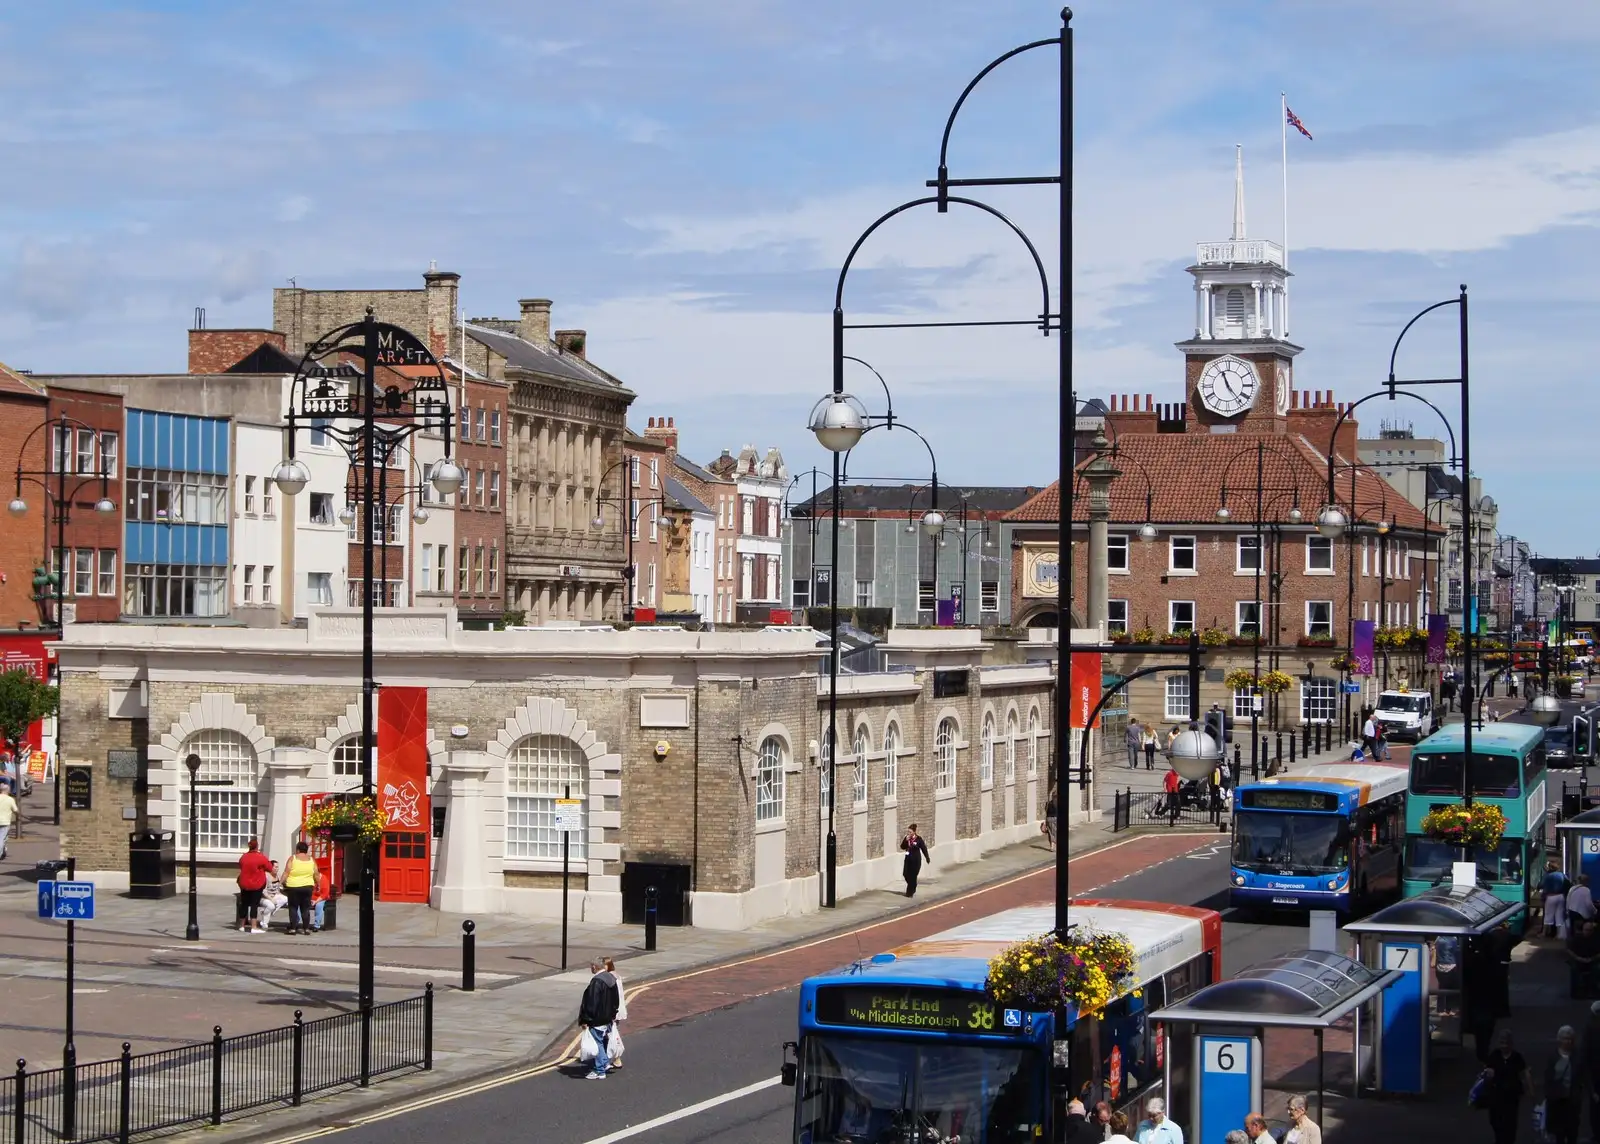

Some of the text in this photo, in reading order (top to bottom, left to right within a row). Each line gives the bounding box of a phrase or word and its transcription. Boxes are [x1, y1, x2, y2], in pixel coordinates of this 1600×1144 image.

[1081, 702, 1089, 726] London
[1589, 838, 1599, 852] 8
[1395, 948, 1409, 969] 7
[871, 995, 940, 1012] Park End
[1217, 1043, 1235, 1071] 6
